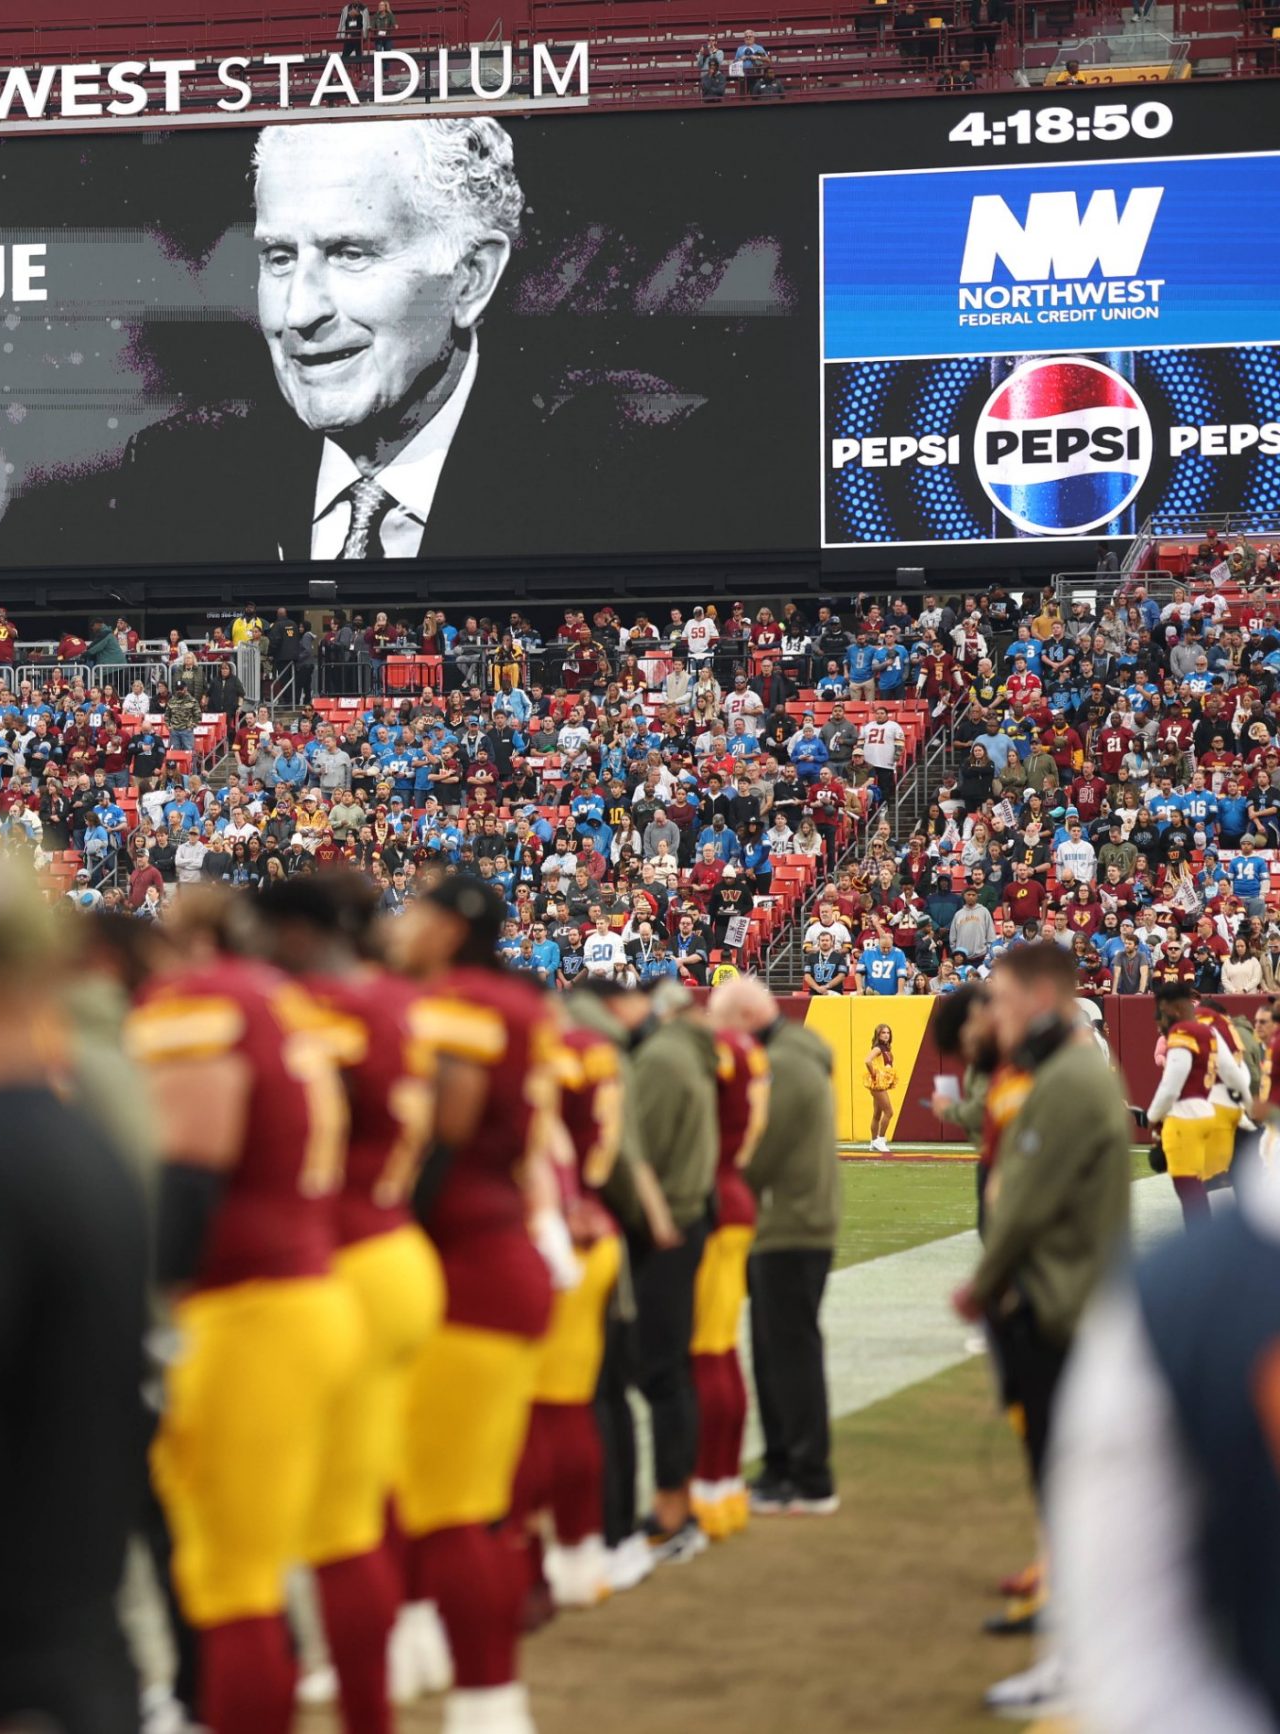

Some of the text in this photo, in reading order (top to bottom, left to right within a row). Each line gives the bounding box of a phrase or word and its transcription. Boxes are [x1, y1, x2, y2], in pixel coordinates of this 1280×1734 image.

[217, 41, 590, 112] STADIUM
[948, 101, 1173, 147] 4:18:50
[959, 187, 1165, 284] NW
[959, 279, 1166, 310] NORTHWEST
[959, 306, 1160, 327] FEDERAL CREDIT UNION
[832, 434, 960, 469] PEPSI
[985, 425, 1141, 466] PEPSI
[691, 626, 706, 639] 59
[856, 652, 864, 669] 9
[1049, 647, 1064, 661] 14
[936, 668, 943, 680] 5
[1191, 679, 1207, 692] 68
[732, 699, 746, 713] 21
[89, 712, 102, 727] 18
[776, 727, 783, 740] 5
[869, 728, 884, 744] 21
[1167, 727, 1181, 739] 17
[248, 740, 256, 755] 5
[564, 735, 582, 750] 97
[1107, 738, 1122, 752] 21
[1079, 788, 1094, 803] 91
[609, 808, 624, 824] 10
[1001, 800, 1013, 823] SALUTE
[1190, 801, 1206, 816] 16
[1024, 849, 1033, 865] 5
[1237, 863, 1254, 879] 14
[1183, 882, 1196, 905] SALUTE
[592, 944, 612, 961] 20
[563, 957, 582, 974] 87
[871, 961, 893, 978] 97
